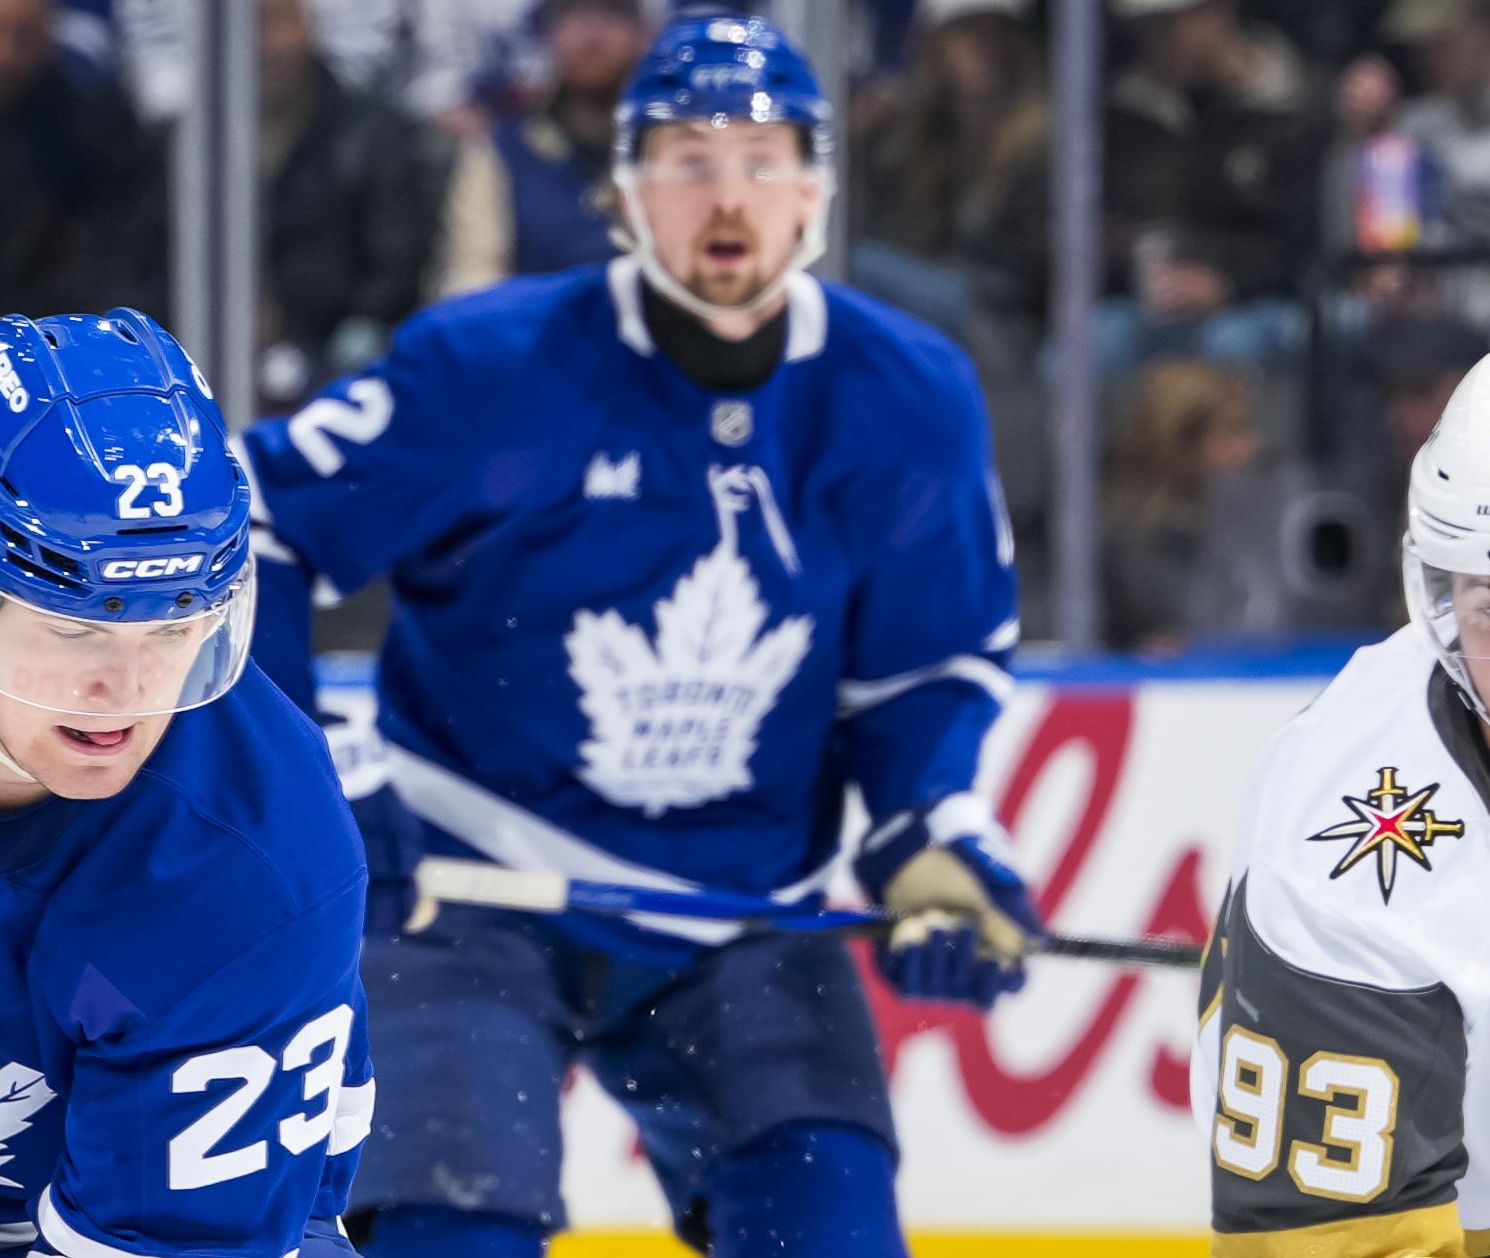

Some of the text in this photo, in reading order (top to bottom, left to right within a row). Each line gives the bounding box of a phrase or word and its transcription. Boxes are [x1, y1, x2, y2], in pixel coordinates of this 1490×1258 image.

[114, 462, 184, 520] 23
[101, 553, 203, 580] CCM
[168, 1002, 356, 1191] 23
[1212, 1022, 1402, 1204] 93
